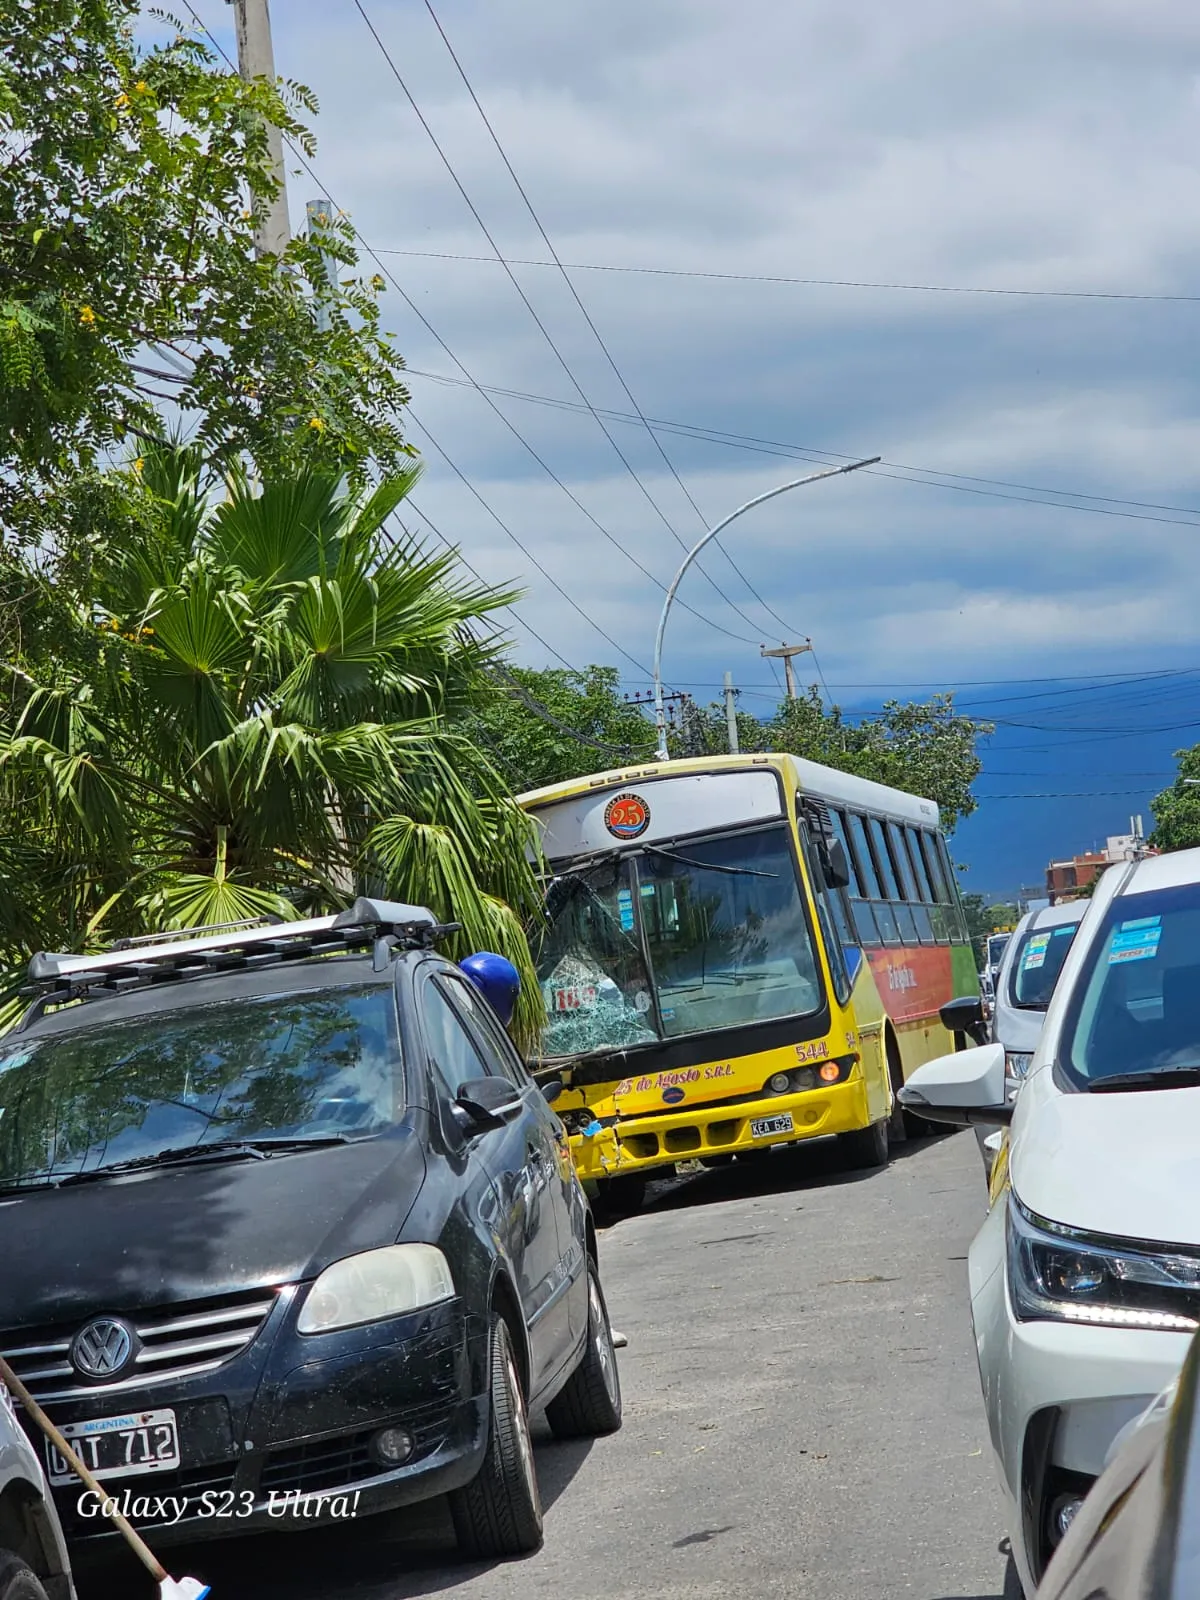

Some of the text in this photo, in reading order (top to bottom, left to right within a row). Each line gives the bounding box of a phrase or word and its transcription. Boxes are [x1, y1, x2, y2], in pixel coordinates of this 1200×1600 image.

[613, 804, 641, 826] 25
[795, 1040, 830, 1063] 544
[613, 1079, 633, 1096] 25
[636, 1076, 652, 1093] de
[655, 1068, 701, 1090] Agosto
[752, 1117, 792, 1136] KEA 629
[83, 1417, 136, 1432] ARGENTINA
[119, 1425, 174, 1464] 712
